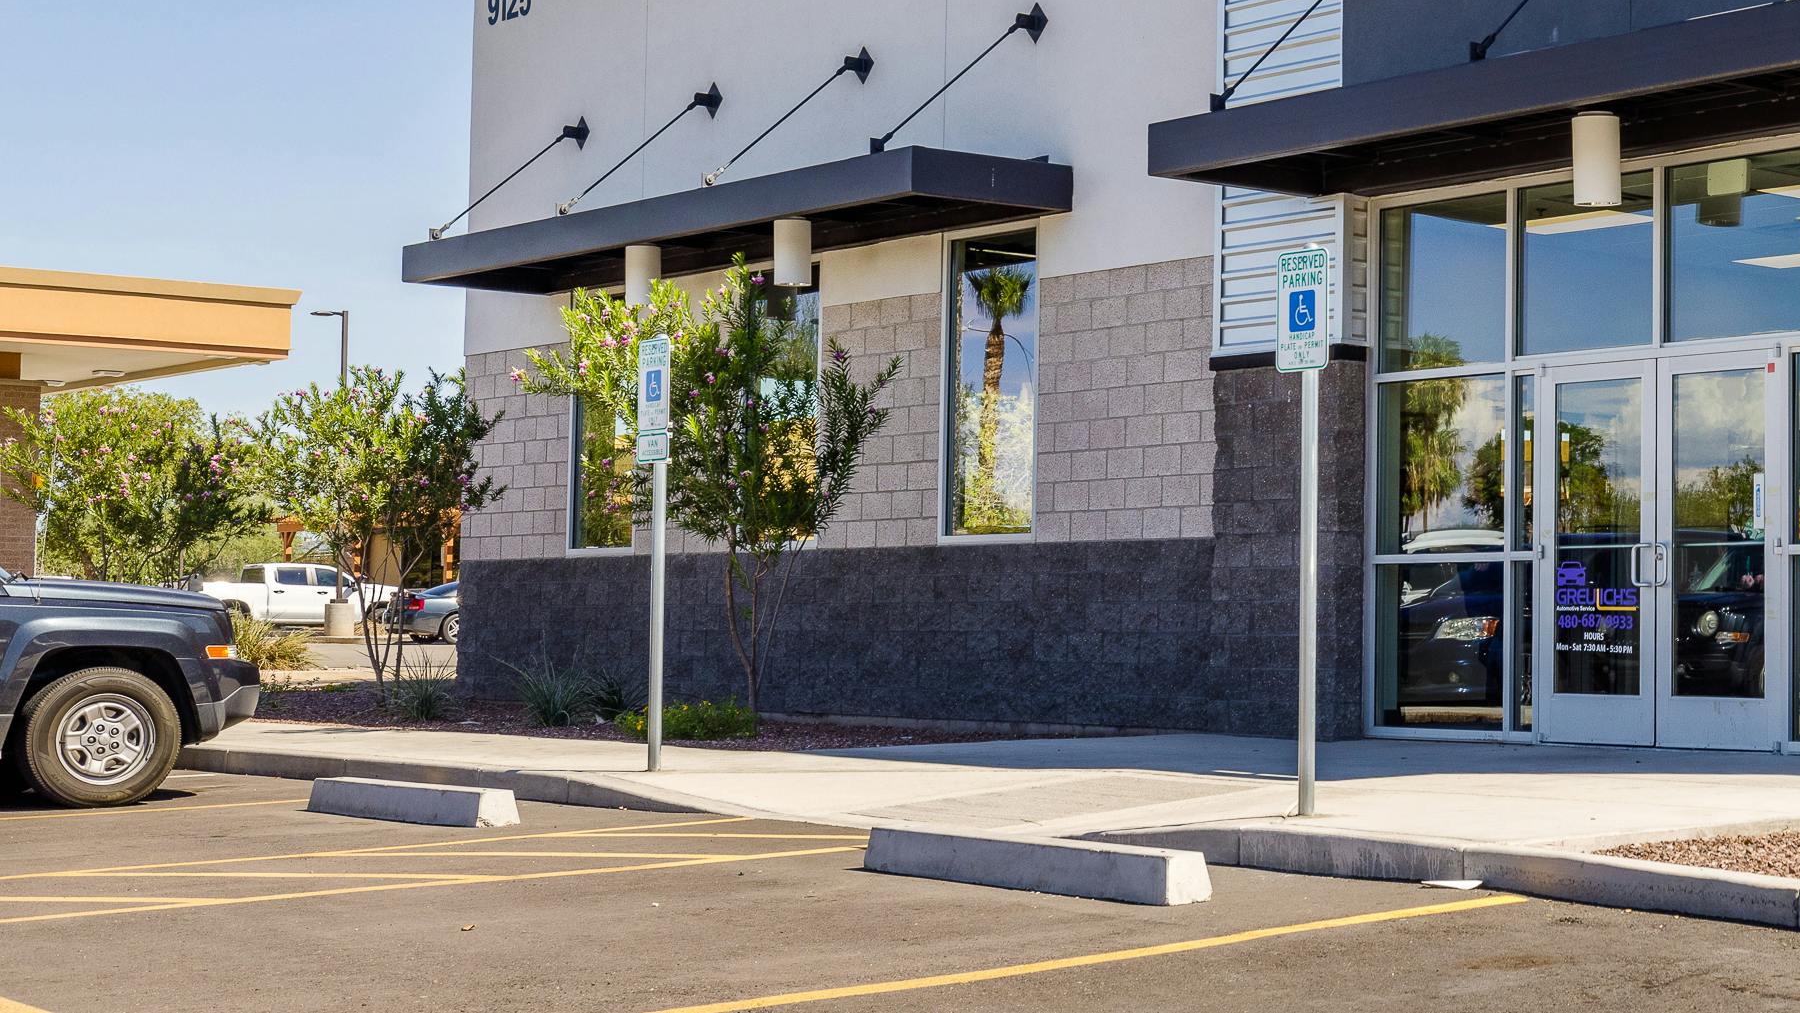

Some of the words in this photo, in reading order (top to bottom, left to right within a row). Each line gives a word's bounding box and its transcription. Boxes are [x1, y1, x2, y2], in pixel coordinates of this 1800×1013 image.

[1282, 253, 1324, 272] RESERVED
[1283, 271, 1322, 289] PARKING
[1289, 332, 1315, 340] HANDICAP
[641, 342, 667, 355] RESERVED
[1281, 342, 1296, 351] PLATE
[1304, 340, 1323, 349] PERMIT
[1294, 351, 1309, 359] ONLY
[642, 355, 666, 367] PARKING
[648, 439, 658, 448] VAN
[1556, 588, 1638, 611] GREULICH'S
[1584, 632, 1604, 641] HOURS
[1556, 643, 1569, 651] Mon
[1572, 643, 1582, 651] Sat
[1584, 644, 1595, 652] 7:30
[1595, 644, 1606, 652] AM
[1610, 645, 1622, 653] 5:30
[1622, 646, 1633, 654] PM
